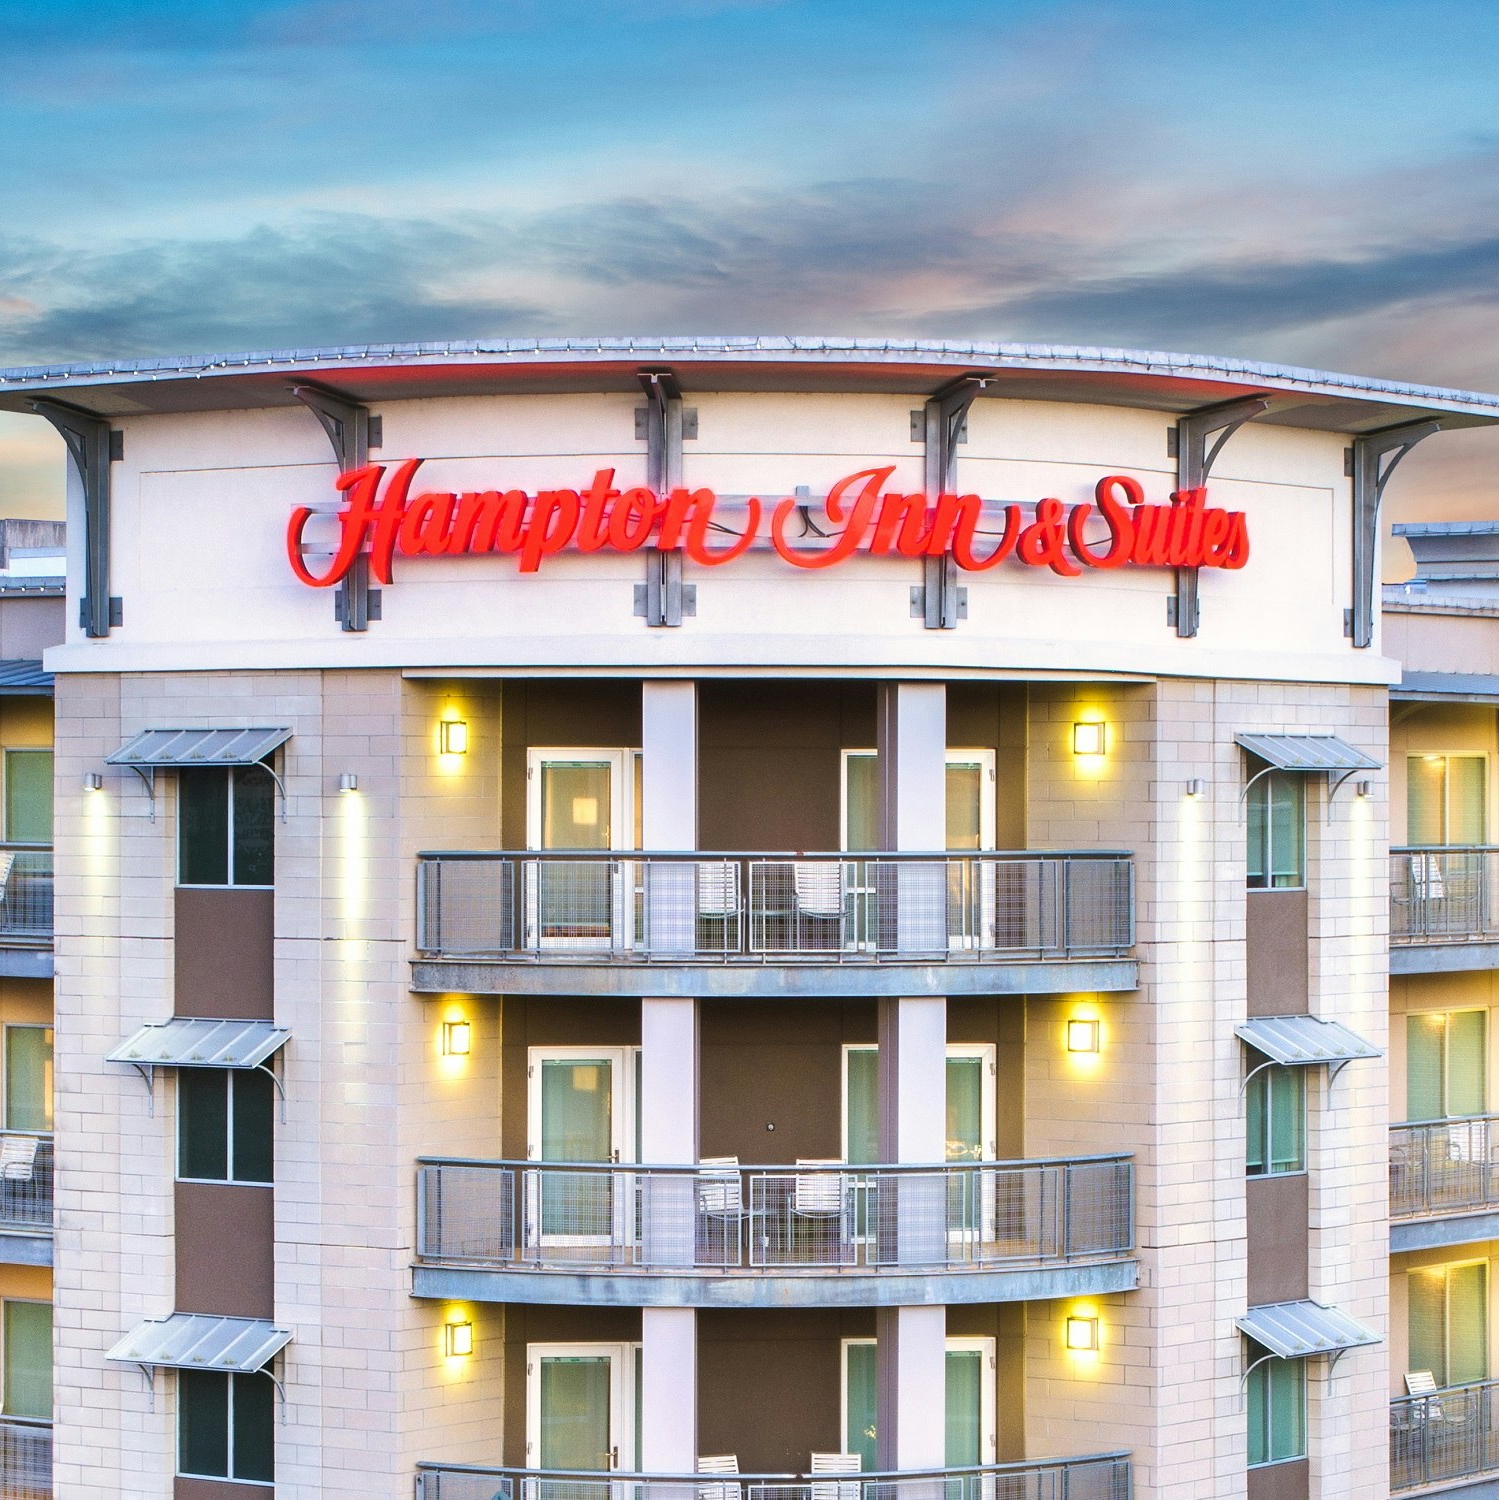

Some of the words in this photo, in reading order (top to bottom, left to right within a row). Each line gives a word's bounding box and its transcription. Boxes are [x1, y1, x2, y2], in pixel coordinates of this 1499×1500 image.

[288, 458, 761, 588] Hampton
[771, 465, 1019, 572] Inn
[1016, 497, 1082, 577] &
[1068, 475, 1250, 570] Suites
